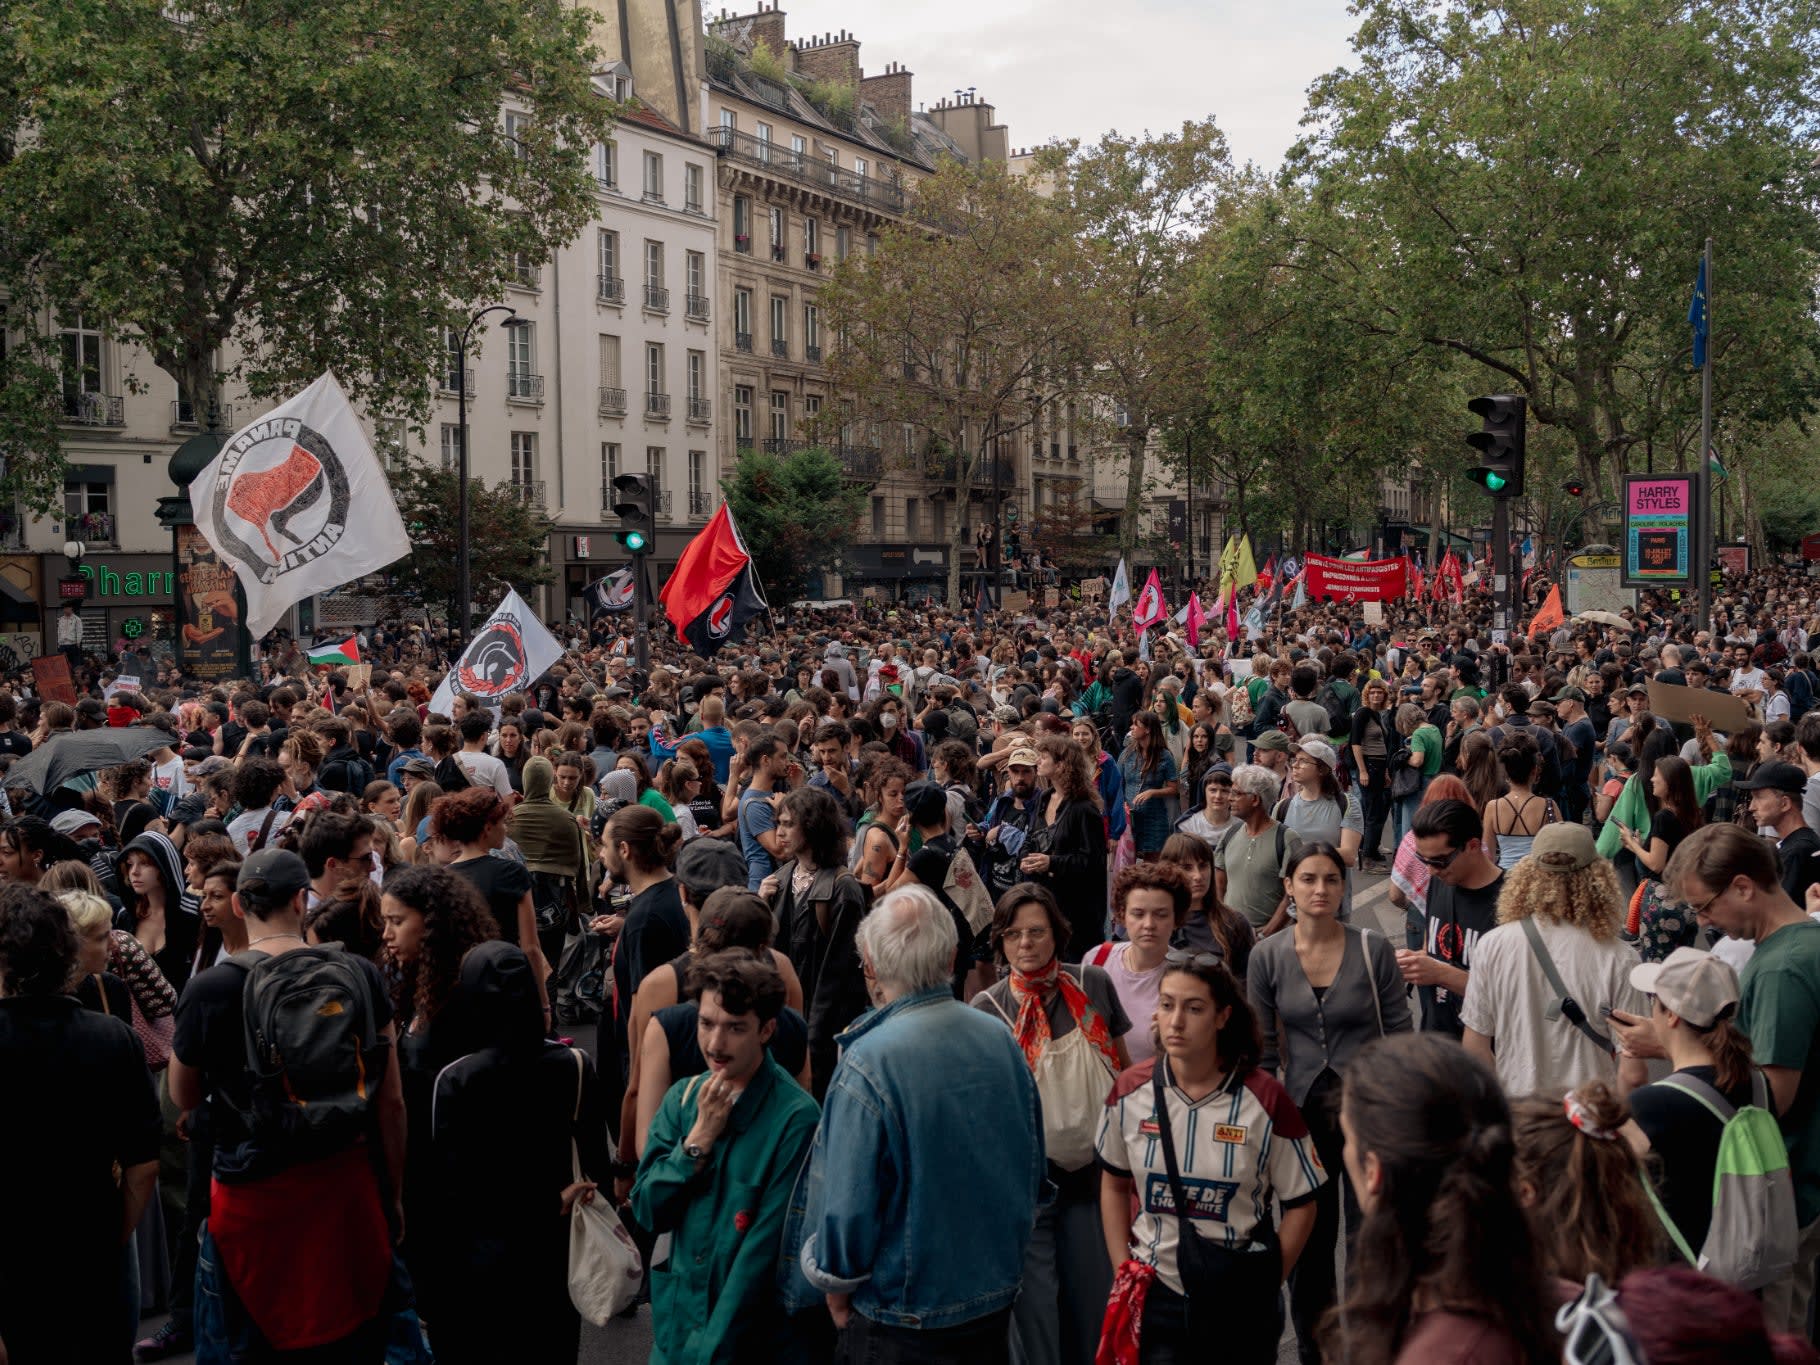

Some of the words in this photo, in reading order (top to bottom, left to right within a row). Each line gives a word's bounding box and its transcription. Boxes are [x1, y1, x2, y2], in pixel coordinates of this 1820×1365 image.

[1638, 486, 1679, 498] HARRY
[1636, 498, 1681, 509] STYLES
[1152, 1181, 1201, 1200] FE
[1151, 1196, 1224, 1214] L'HUNITE
